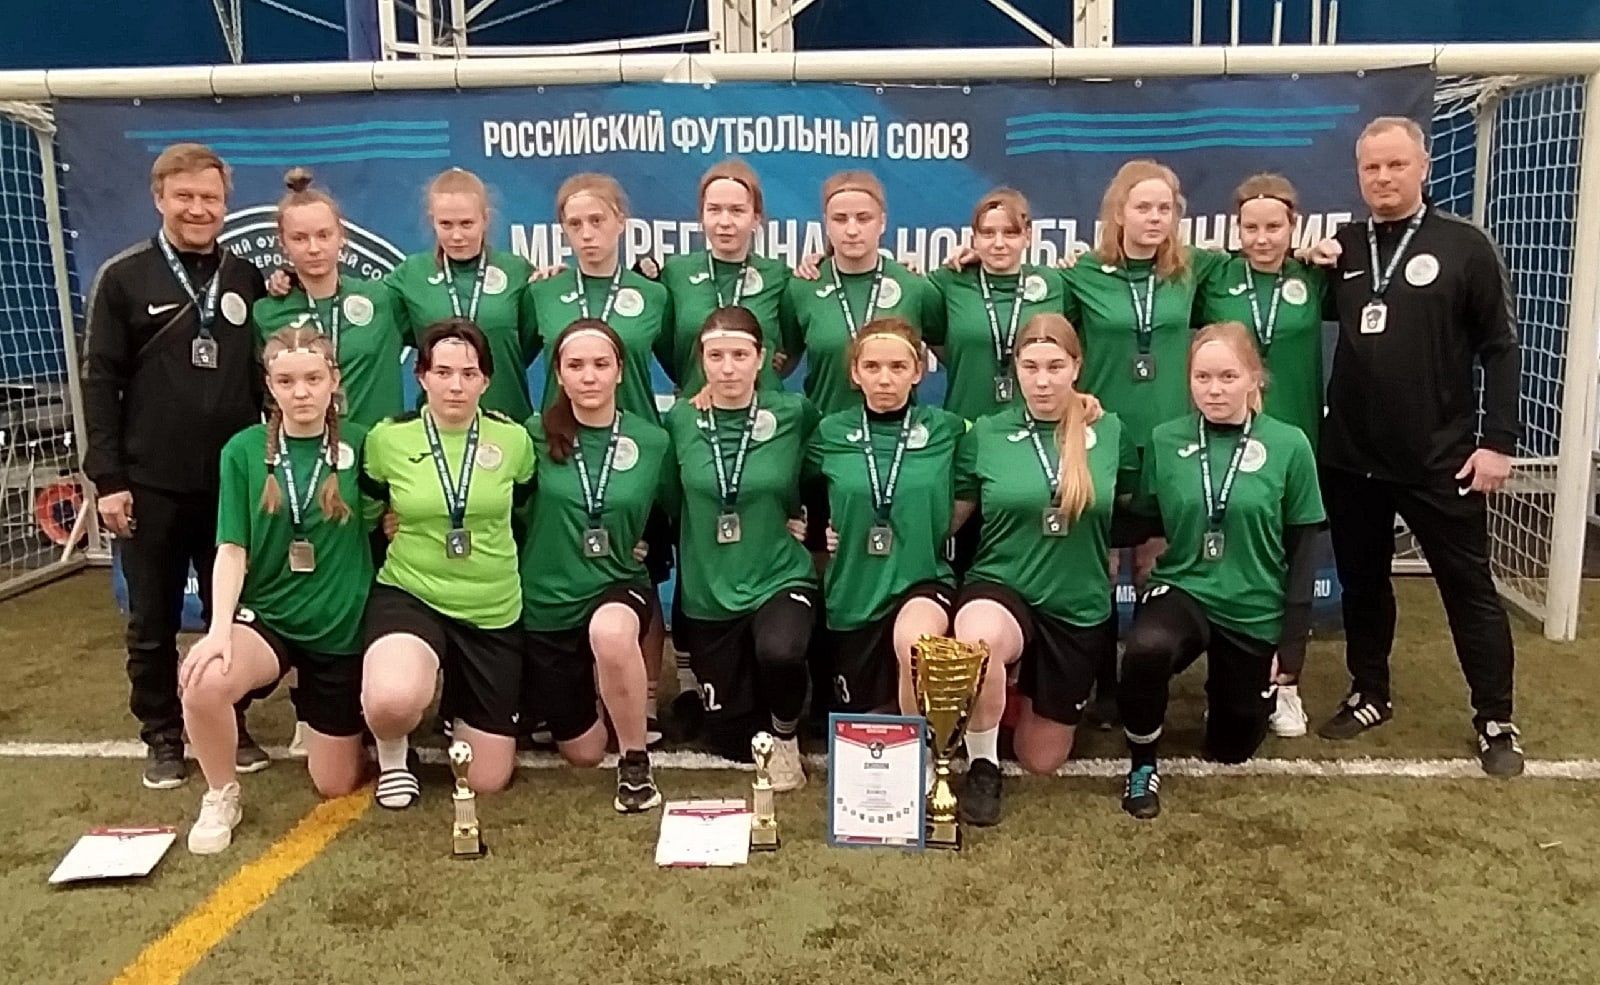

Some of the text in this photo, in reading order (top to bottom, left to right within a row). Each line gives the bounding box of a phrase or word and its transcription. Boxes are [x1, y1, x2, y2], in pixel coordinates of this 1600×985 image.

[483, 109, 969, 159] РОССИЙСКИЙ ФУТБОЛЬНЫЙ СОЮЗ
